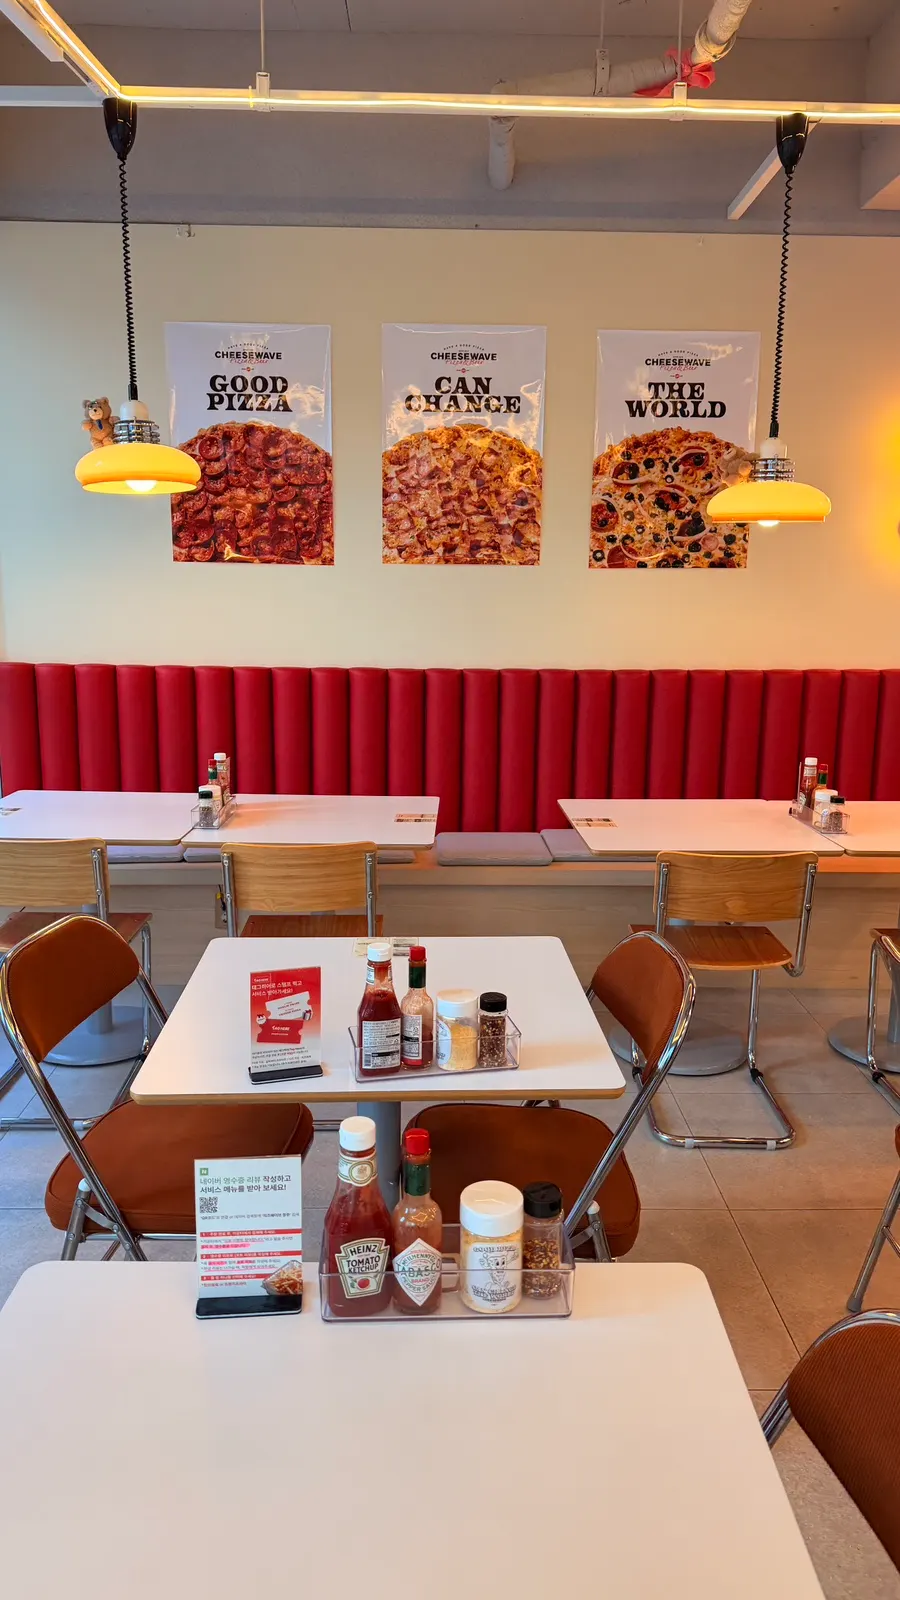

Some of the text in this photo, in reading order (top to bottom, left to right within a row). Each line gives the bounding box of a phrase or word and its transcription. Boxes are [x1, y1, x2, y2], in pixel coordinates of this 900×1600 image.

[215, 351, 282, 359] CHEESEWAVE
[430, 352, 497, 360] CHEESEWAVE
[645, 358, 711, 366] CHEESEWAVE
[209, 374, 288, 394] GOOD
[434, 376, 492, 394] CAN
[648, 382, 705, 400] THE
[206, 392, 293, 412] PIZZA
[404, 394, 521, 414] CHANGE
[625, 400, 727, 418] WORLD
[200, 1177, 222, 1185] 네이버
[223, 1176, 245, 1184] 영수증
[262, 1175, 291, 1183] 작성하고
[223, 1185, 245, 1193] 메뉴를
[247, 1184, 261, 1192] 받아
[262, 1184, 286, 1192] 보세요!
[350, 1245, 378, 1256] HEINZ
[346, 1255, 380, 1268] TOMATO
[396, 1258, 440, 1277] TABASCO
[348, 1263, 379, 1274] KETCHUP
